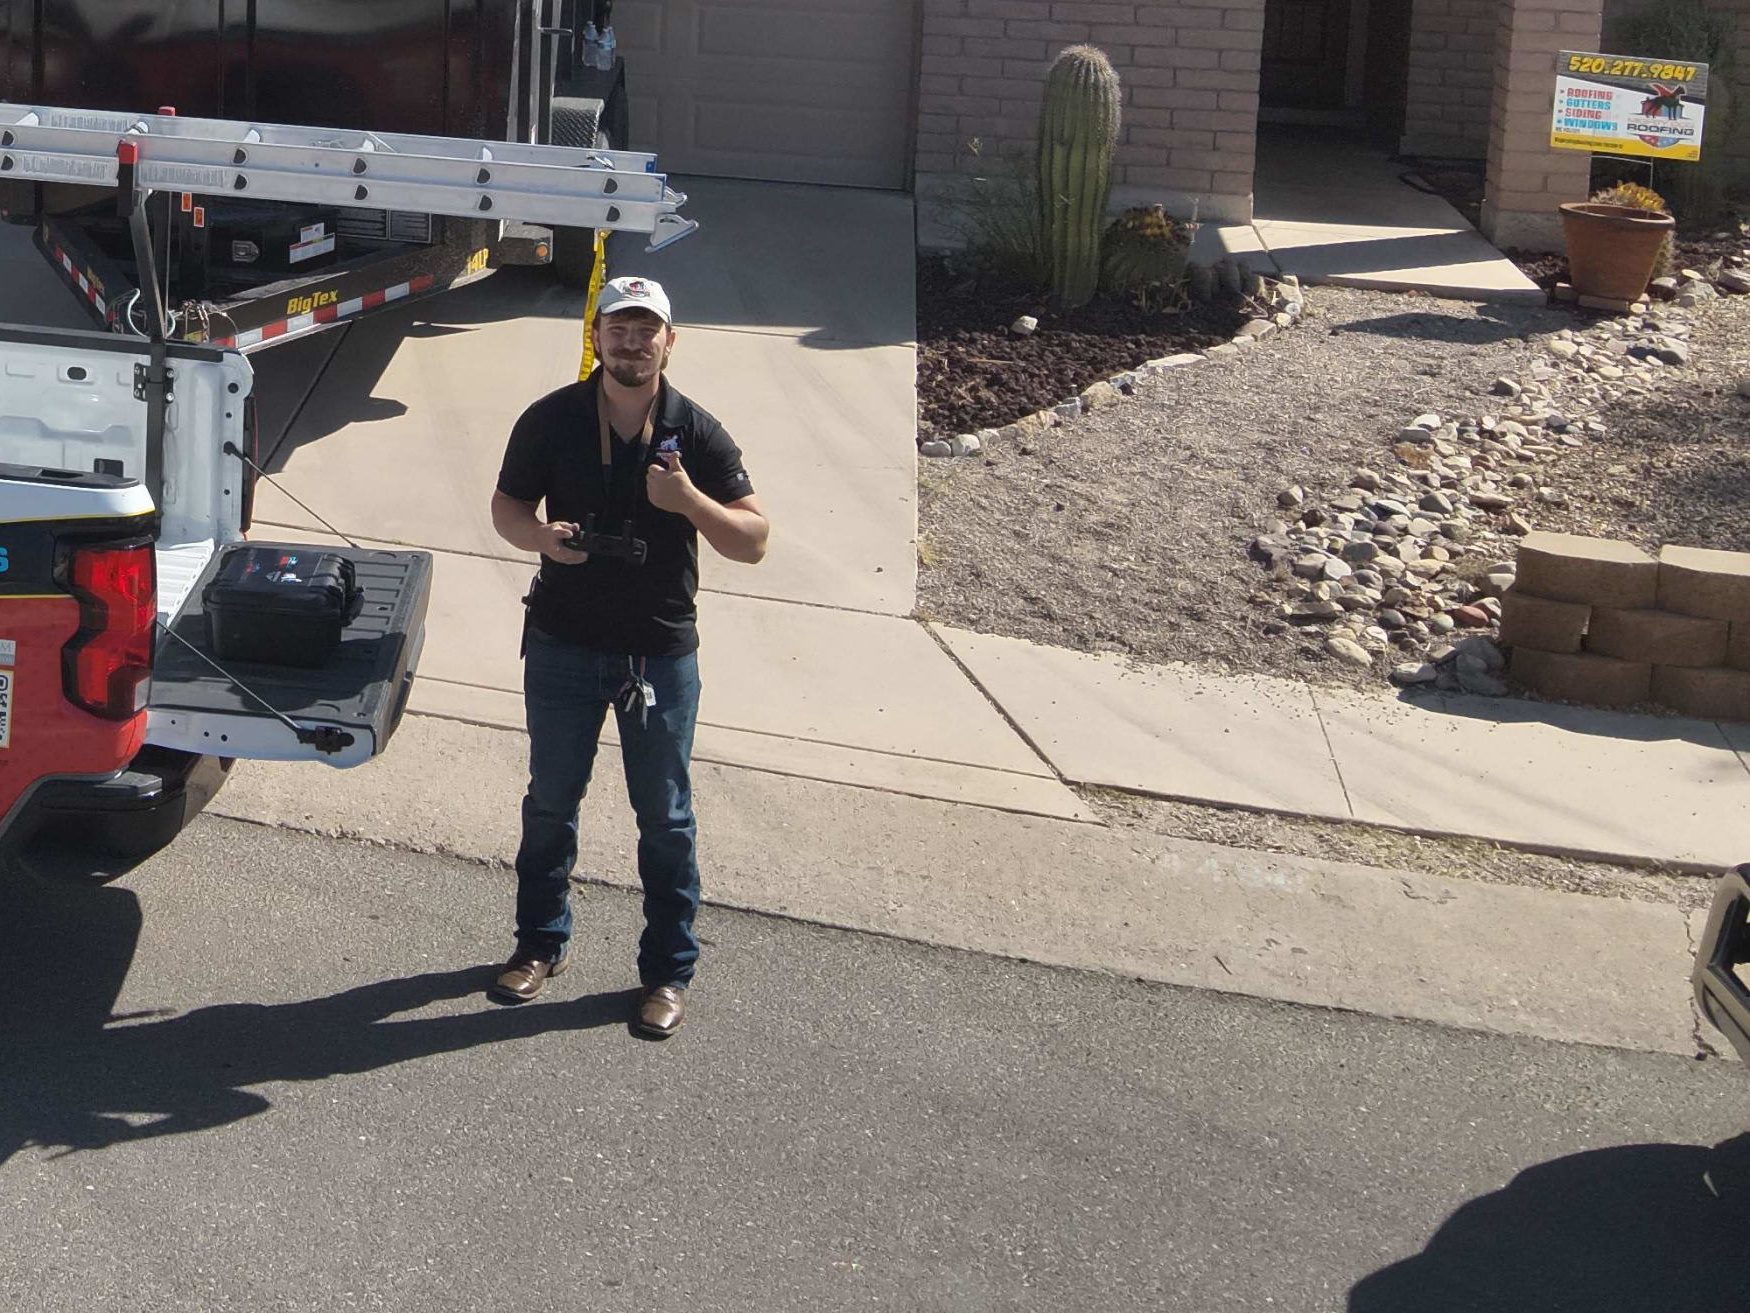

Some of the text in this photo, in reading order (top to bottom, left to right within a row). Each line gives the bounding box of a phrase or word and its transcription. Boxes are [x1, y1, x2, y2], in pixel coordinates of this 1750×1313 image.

[1568, 55, 1697, 82] 520.277.9847
[1566, 87, 1614, 101] ROOFING
[1565, 98, 1611, 110] GUTTERS
[1564, 108, 1602, 120] SIDING
[1563, 117, 1618, 131] WINDOWS
[1626, 122, 1695, 136] ROOFING
